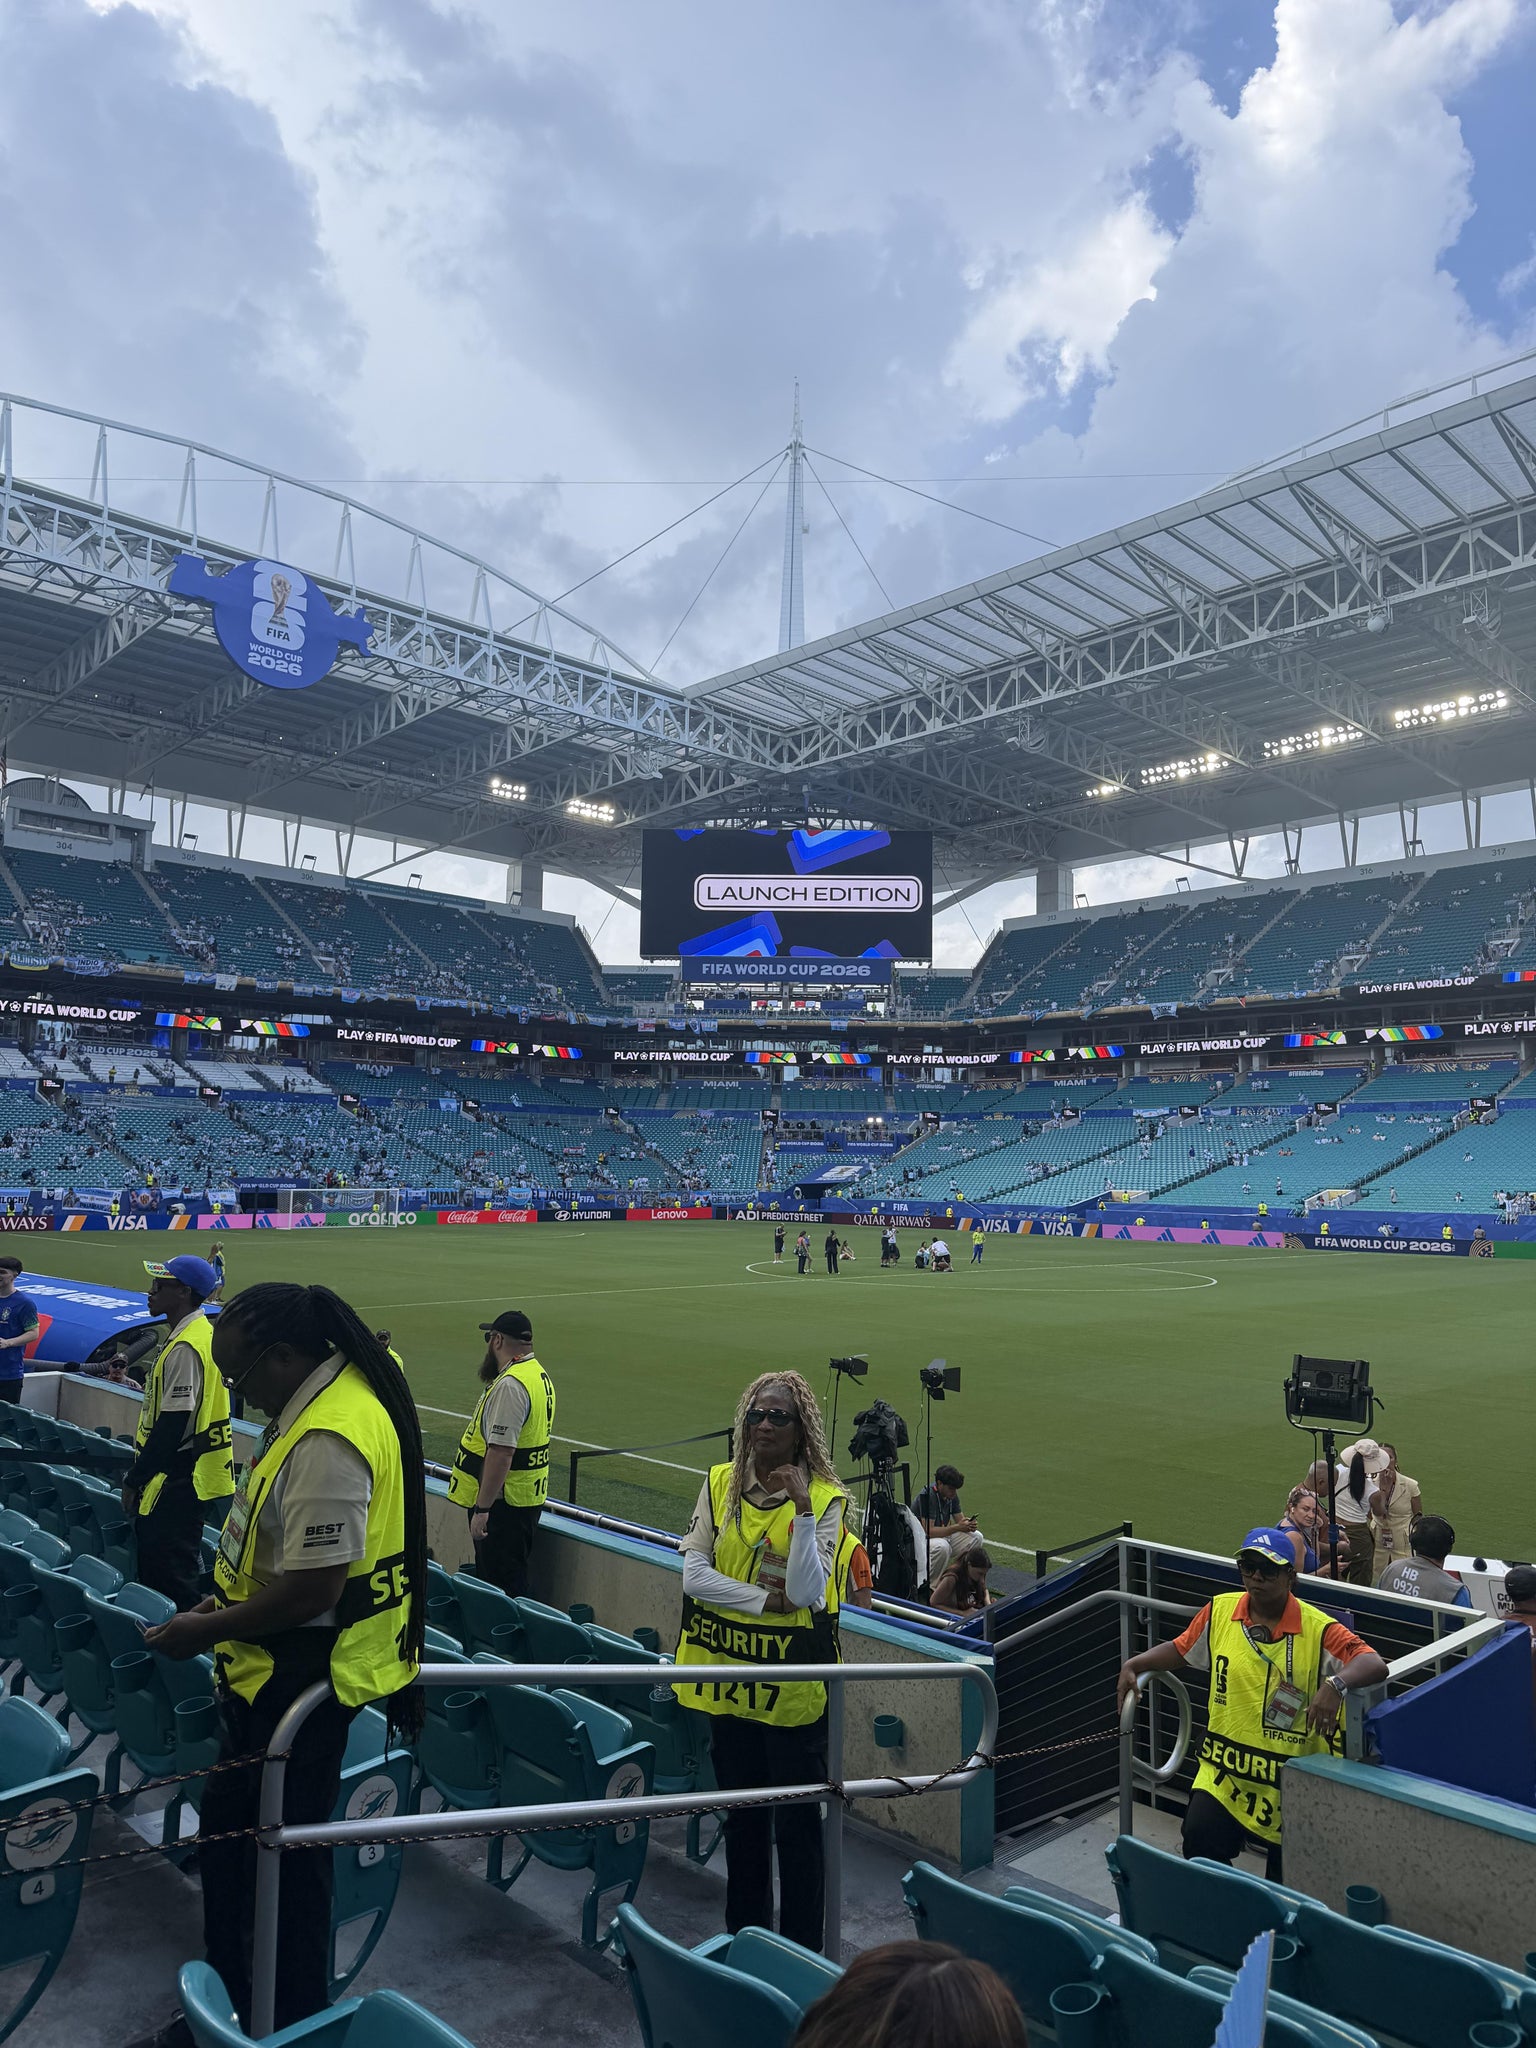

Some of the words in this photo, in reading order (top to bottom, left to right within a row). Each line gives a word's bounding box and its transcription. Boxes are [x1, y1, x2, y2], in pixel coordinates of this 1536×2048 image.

[266, 627, 290, 642] FIFA
[249, 642, 284, 658] WORLD
[284, 652, 303, 664] CUP
[248, 652, 302, 677] 2026
[56, 841, 72, 850] 304
[1492, 848, 1506, 857] 317
[182, 852, 196, 862] 305
[300, 872, 314, 881] 306
[1360, 868, 1374, 876] 316
[707, 886, 808, 901] LAUNCH
[814, 887, 910, 902] EDITION
[702, 964, 732, 975] FIFA
[735, 964, 787, 976] WORLD
[789, 964, 818, 976] CUP
[820, 965, 871, 976] 2026
[1359, 984, 1384, 994] PLAY
[1393, 982, 1416, 992] FIFA
[1416, 978, 1453, 990] WORLD
[1454, 977, 1475, 986] CUP
[23, 1002, 55, 1016] FIFA
[56, 1005, 107, 1020] WORLD
[109, 1009, 137, 1022] CUP
[1464, 1023, 1500, 1036] PLAY
[1514, 1020, 1536, 1032] FIF
[337, 1029, 364, 1041] PLAY
[374, 1032, 398, 1044] FIFA
[400, 1034, 436, 1046] WORLD
[437, 1037, 458, 1048] CUP
[82, 1044, 104, 1055] ORLD
[106, 1047, 125, 1056] CUP
[127, 1048, 159, 1058] 2026
[1140, 1044, 1166, 1055] PLAY
[1176, 1042, 1200, 1052] FIFA
[1202, 1038, 1242, 1051] WORLD
[1242, 1037, 1266, 1049] CUP
[614, 1052, 640, 1061] PLAY
[649, 1052, 672, 1061] FIFA
[673, 1052, 708, 1062] WORLD
[710, 1052, 731, 1062] CUP
[887, 1054, 912, 1064] PLAY
[922, 1055, 945, 1064] FIFA
[946, 1054, 980, 1064] WORLD
[980, 1054, 998, 1064] CUP
[704, 1080, 739, 1088] MIAMI
[1054, 1079, 1087, 1087] MIAMI
[430, 1191, 457, 1205] PUAN
[651, 1209, 688, 1219] Lenovo
[893, 1203, 908, 1212] FIFA
[348, 1212, 417, 1226] aramco
[572, 1210, 611, 1220] HYUNDAI
[736, 1210, 760, 1220] ADI
[762, 1211, 824, 1222] PREDICTSTREET
[854, 1214, 885, 1226] QATAR
[890, 1216, 931, 1228] AIRWAYS
[0, 1216, 48, 1230] WAYS
[104, 1215, 148, 1230] VISA
[980, 1218, 1010, 1232] VISA
[1041, 1221, 1074, 1236] VISA
[1315, 1237, 1339, 1248] FIFA
[1340, 1238, 1382, 1250] WORLD
[1383, 1240, 1407, 1250] CUP
[1409, 1241, 1452, 1252] 2026
[305, 1522, 345, 1536] BEST
[1400, 1566, 1420, 1582] HB
[1392, 1578, 1420, 1598] 0926
[686, 1614, 793, 1660] SECURITY
[1263, 1729, 1306, 1744] FIFA.com
[622, 1825, 630, 1838] 2
[367, 1845, 376, 1860] 3
[32, 1880, 44, 1896] 4
